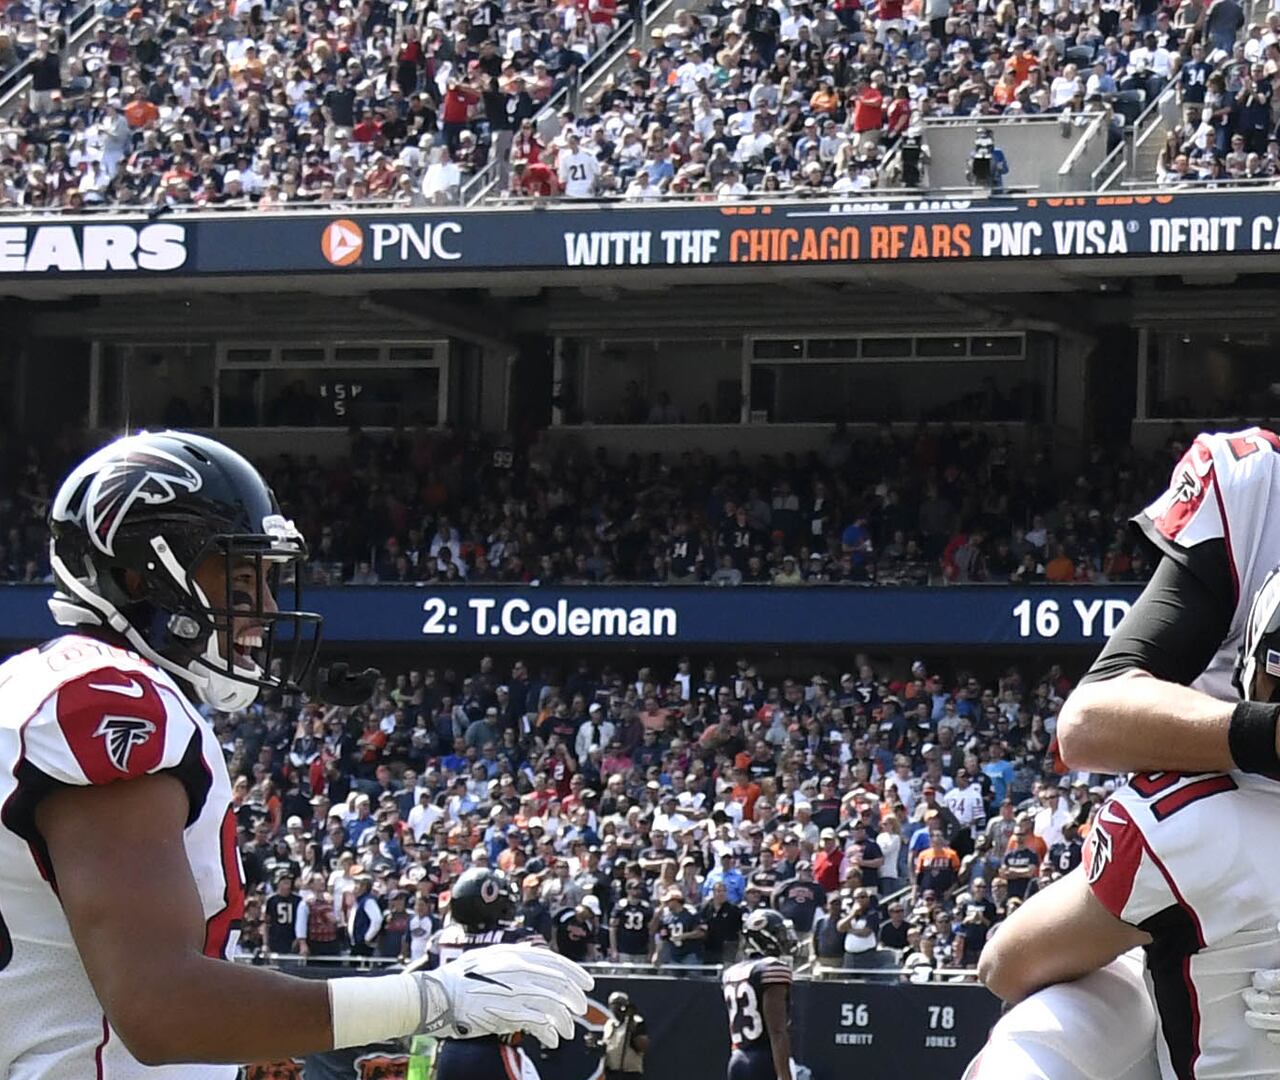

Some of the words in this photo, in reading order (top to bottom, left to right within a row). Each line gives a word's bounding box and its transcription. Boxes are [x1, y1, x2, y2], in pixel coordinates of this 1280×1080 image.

[1189, 68, 1205, 85] 34
[569, 164, 587, 181] 21
[369, 222, 462, 262] PNC
[564, 231, 651, 266] WITH
[660, 229, 720, 264] THE
[728, 226, 860, 263] CHICAGO
[870, 223, 972, 258] BEARS
[981, 221, 1042, 257] PNC
[1149, 216, 1243, 253] DEBIT
[422, 598, 458, 634] 2:
[468, 598, 677, 636] T.Coleman
[1013, 599, 1060, 637] 16
[276, 902, 293, 923] 51
[624, 910, 645, 930] 33
[724, 982, 764, 1043] 23
[840, 1003, 869, 1027] 56
[927, 1006, 955, 1029] 78
[925, 1036, 956, 1047] JONES
